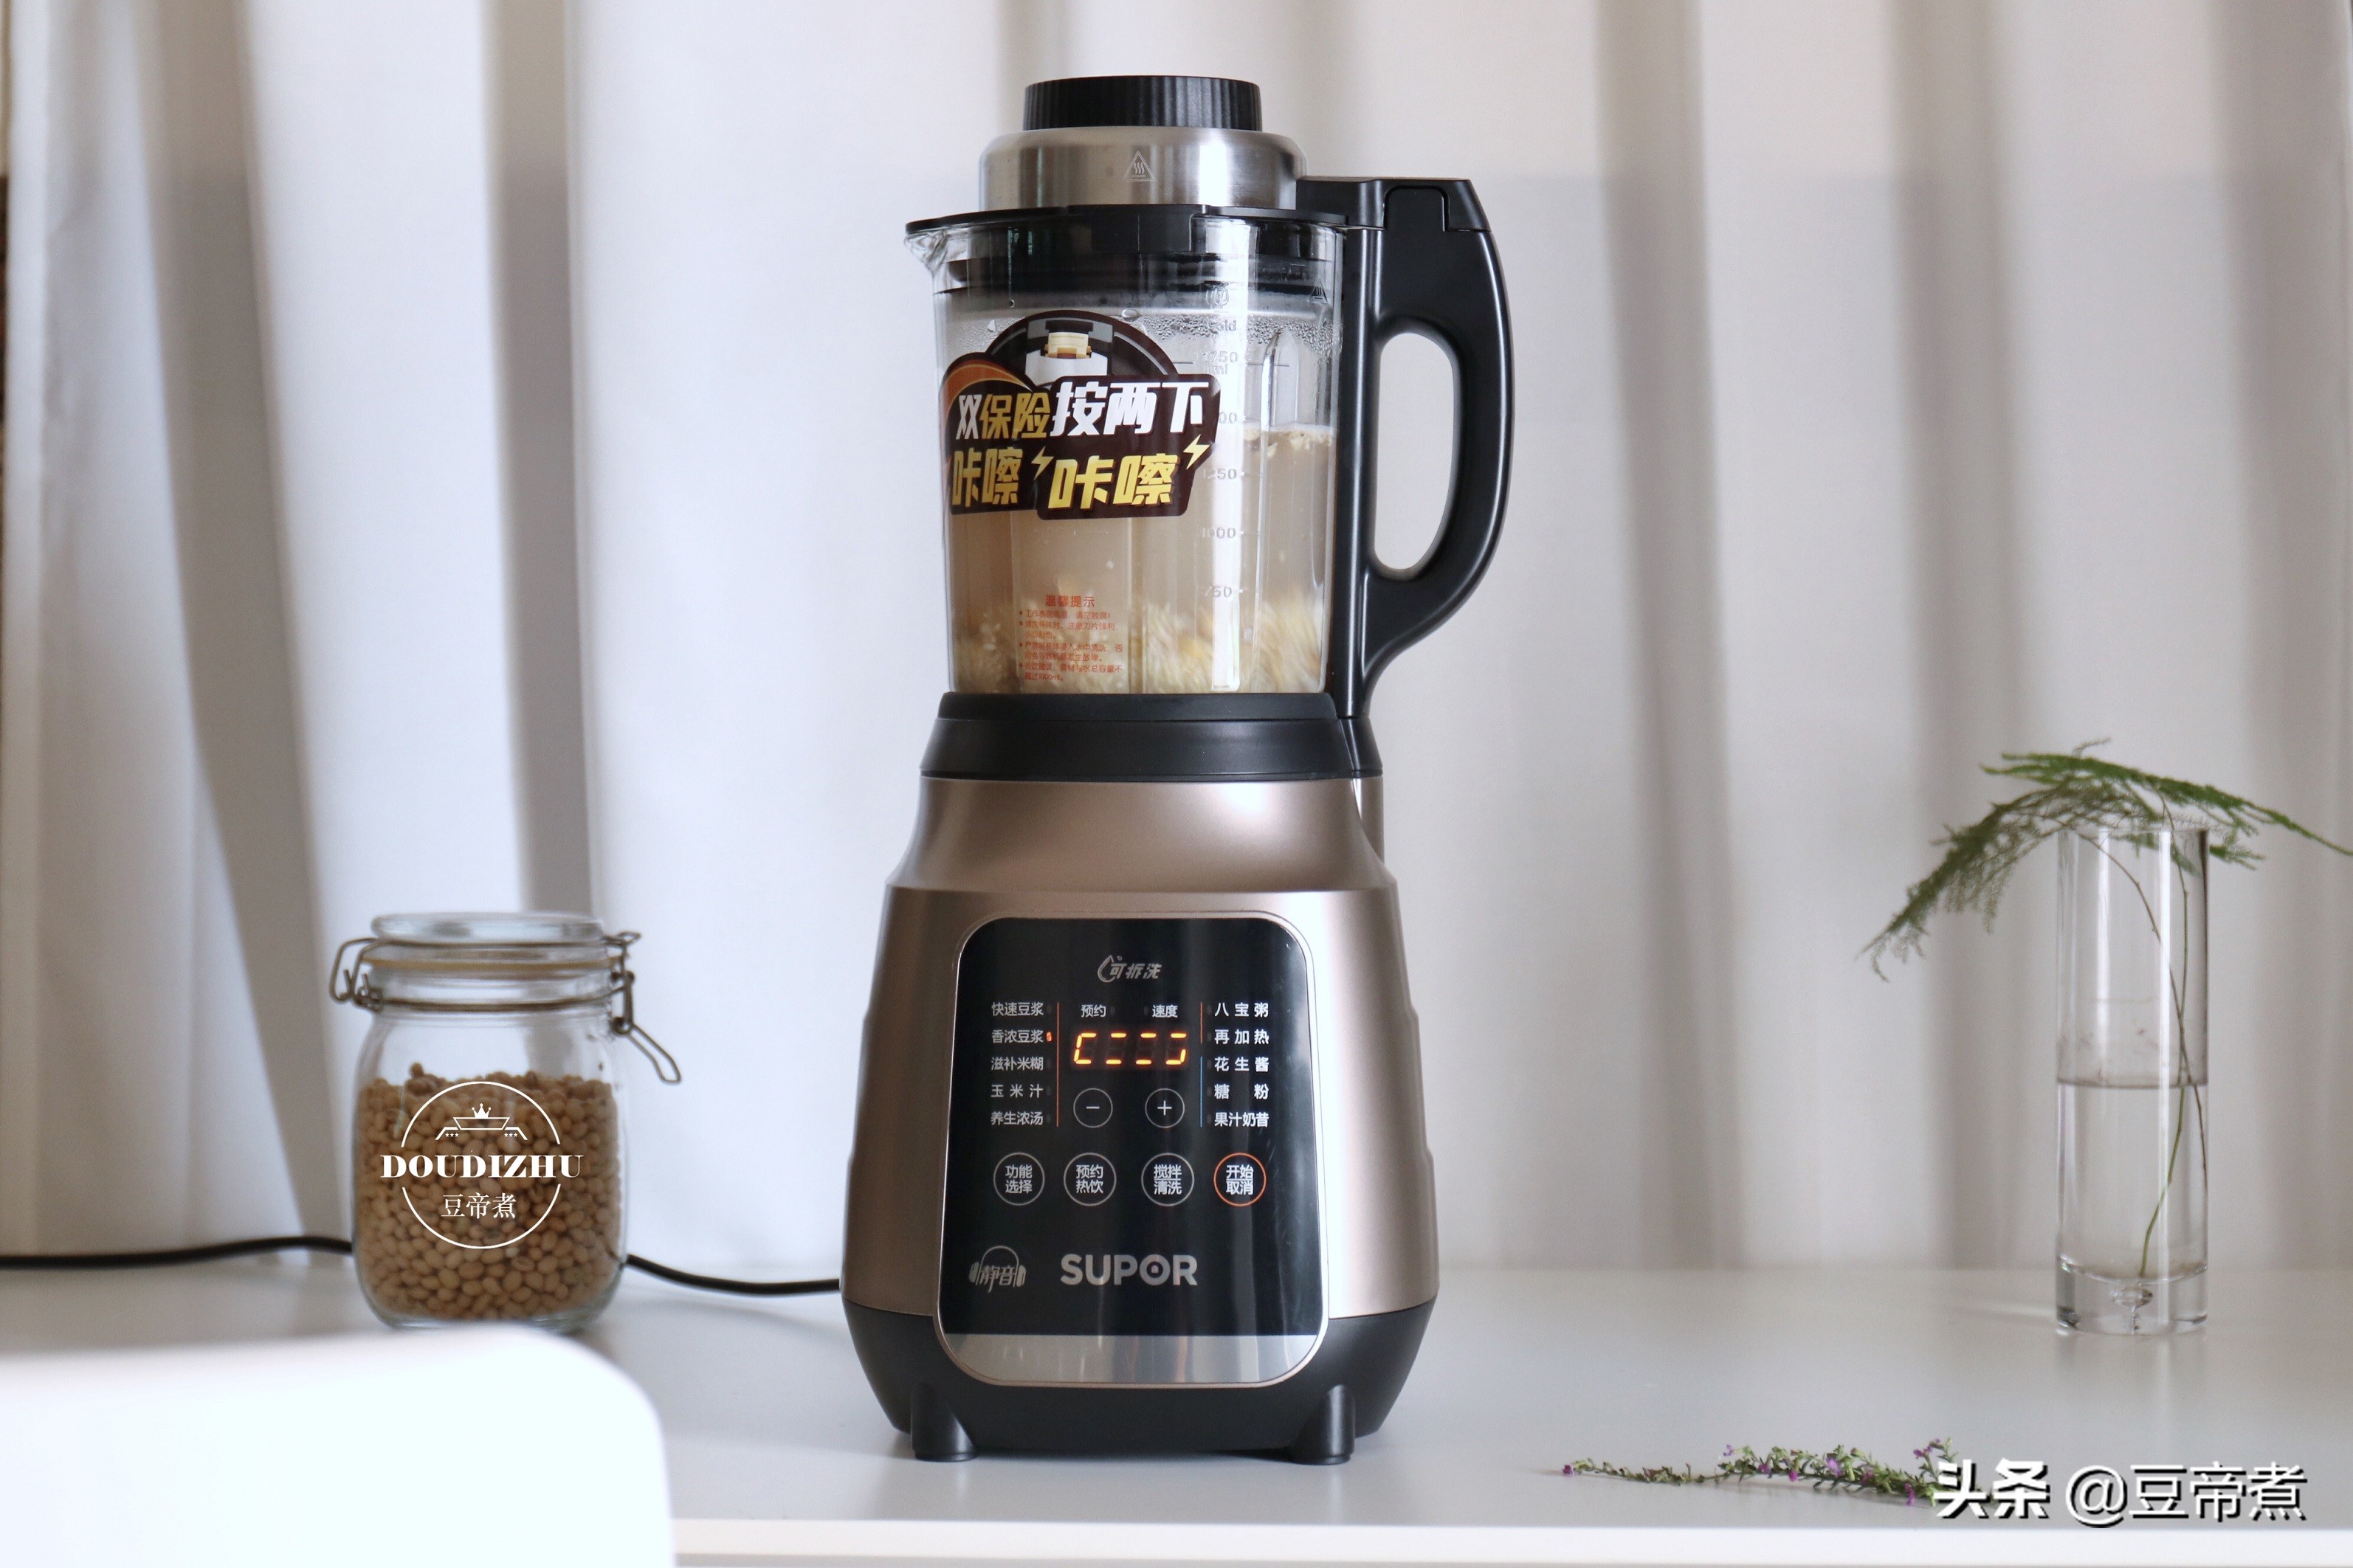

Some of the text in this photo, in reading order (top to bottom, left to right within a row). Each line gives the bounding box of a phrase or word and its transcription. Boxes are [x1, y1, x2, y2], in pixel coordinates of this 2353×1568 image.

[956, 381, 1209, 440] 双保险 按两下
[952, 447, 1179, 510] 咔嚓 咔嚓
[1045, 594, 1095, 607] 温馨提示
[991, 1001, 1044, 1017] 快速豆浆
[1081, 1004, 1106, 1018] 预约
[1151, 1004, 1178, 1018] 速度
[1214, 1001, 1269, 1018] 八宝粥
[992, 1029, 1044, 1043] 香浓豆浆
[1214, 1028, 1269, 1045] 再加热
[991, 1056, 1044, 1071] 滋补米糊
[1214, 1056, 1269, 1072] 花生酱
[991, 1083, 1044, 1099] 玉米汁
[1214, 1083, 1269, 1100] 糖粉
[991, 1111, 1044, 1126] 养生浓汤
[1214, 1111, 1269, 1127] 果汁奶昔
[1005, 1164, 1033, 1181] 功能
[1075, 1164, 1103, 1179] 预约
[1153, 1164, 1182, 1180] 搅拌
[1225, 1164, 1254, 1180] 开始
[1005, 1179, 1033, 1194] 选择
[1075, 1179, 1104, 1194] 热饮
[1154, 1179, 1182, 1195] 清洗
[1225, 1179, 1254, 1195] 取消
[1060, 1254, 1198, 1286] SUPOR
